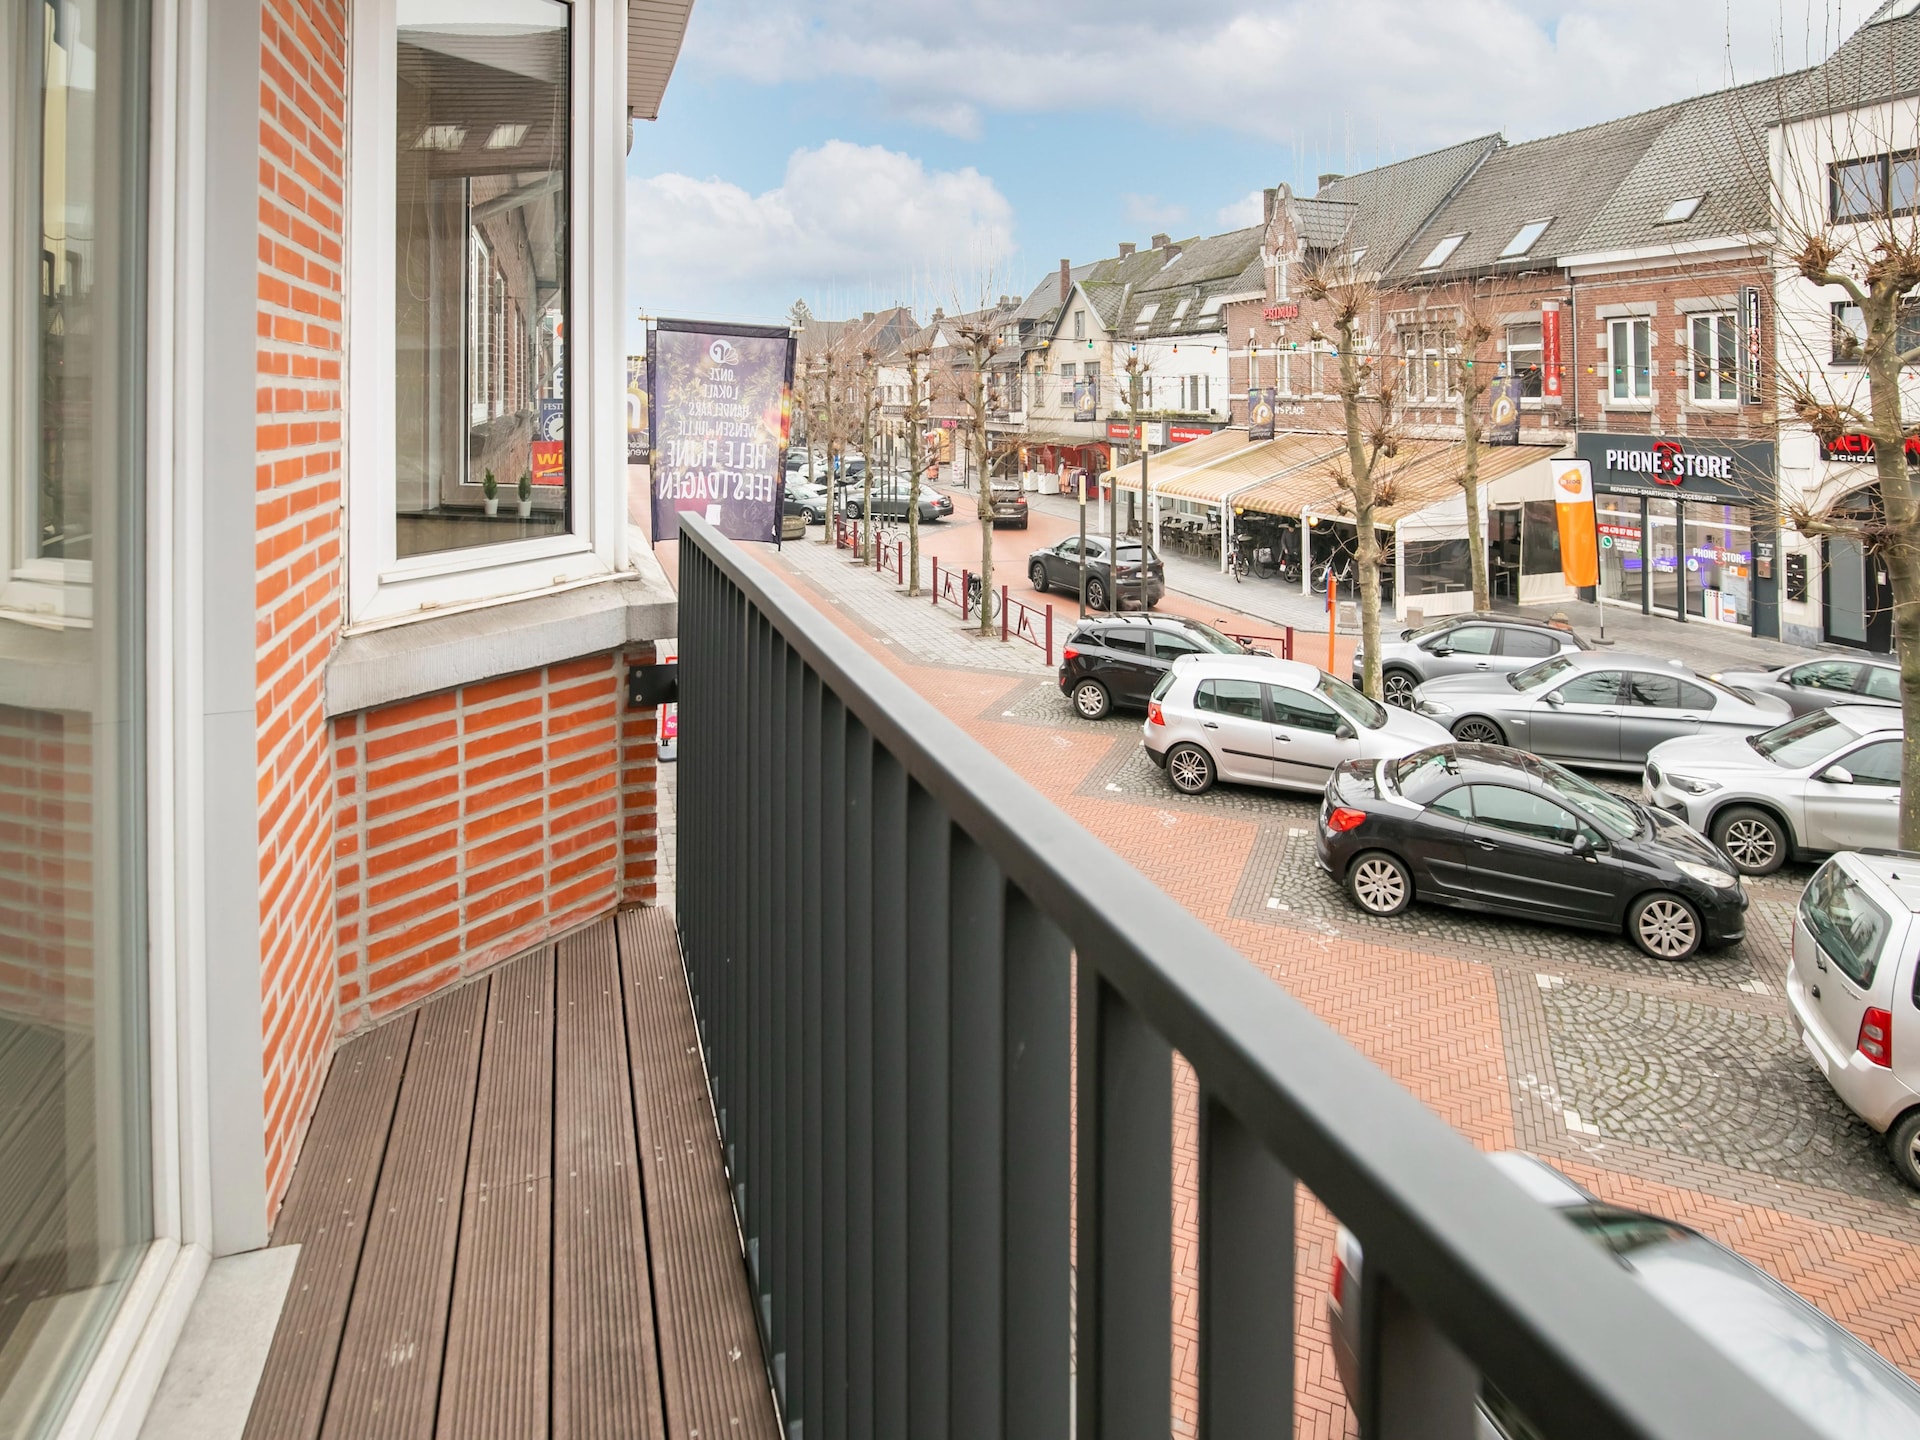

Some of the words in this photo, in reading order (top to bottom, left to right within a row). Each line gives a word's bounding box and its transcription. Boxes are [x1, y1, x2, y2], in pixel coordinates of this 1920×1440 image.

[1263, 304, 1298, 320] PRIMUS
[1285, 406, 1305, 415] PLACE
[1606, 450, 1663, 474] PHONE
[1673, 454, 1733, 479] STORE
[1692, 548, 1717, 560] PHONE
[1721, 552, 1747, 565] STORE
